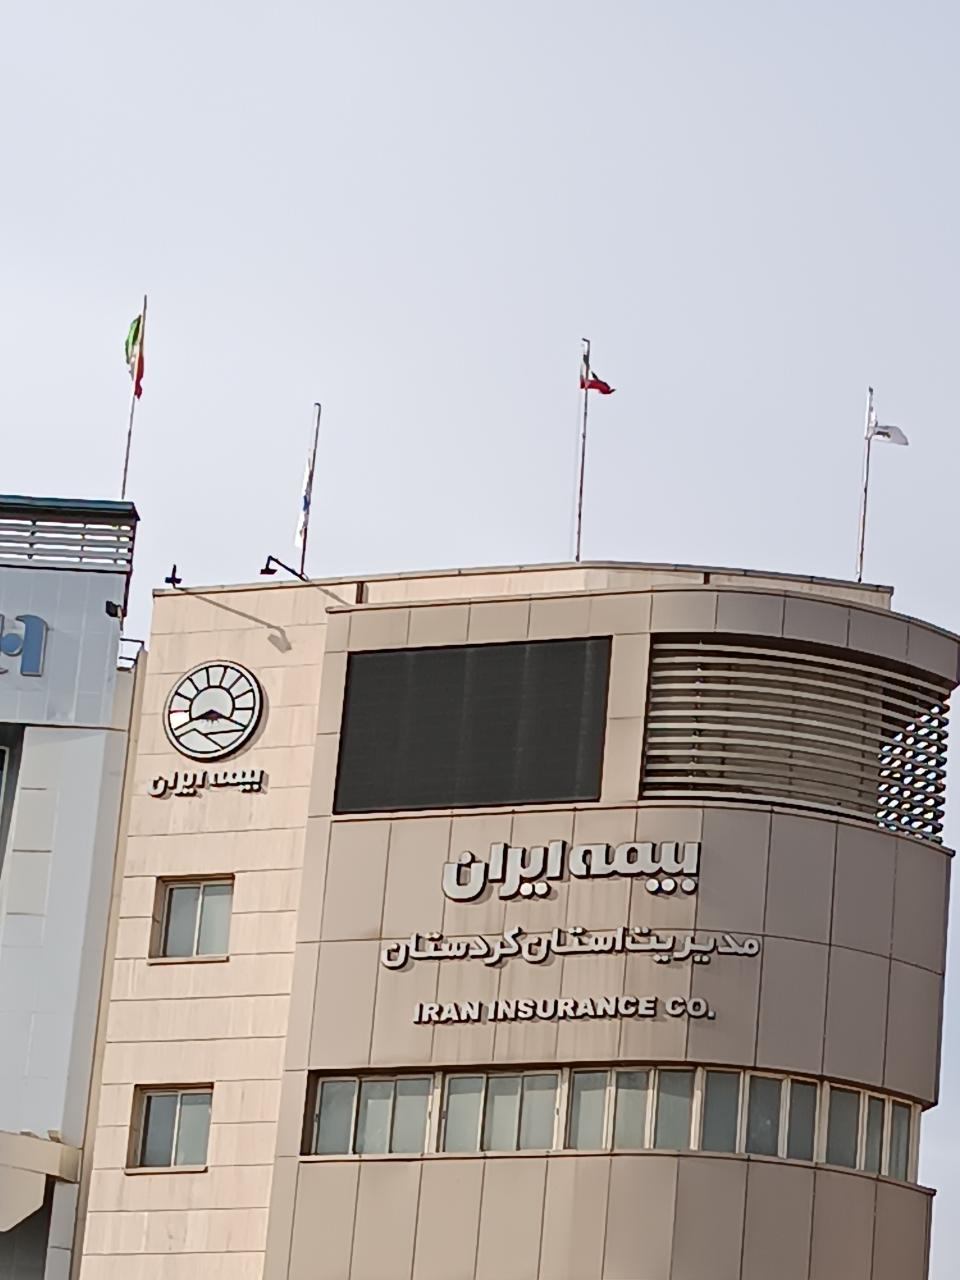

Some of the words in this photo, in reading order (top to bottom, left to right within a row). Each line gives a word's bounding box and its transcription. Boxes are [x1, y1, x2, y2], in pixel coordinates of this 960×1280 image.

[147, 770, 208, 799] ایران
[206, 769, 266, 794] بیمه
[441, 839, 568, 902] ایران
[568, 841, 700, 895] بیمه
[381, 926, 523, 970] کردستان
[521, 926, 626, 965] استان
[625, 926, 760, 964] مدیریت
[413, 1001, 484, 1024] IRAN
[488, 996, 657, 1022] INSURANCE
[665, 995, 716, 1019] CO.
